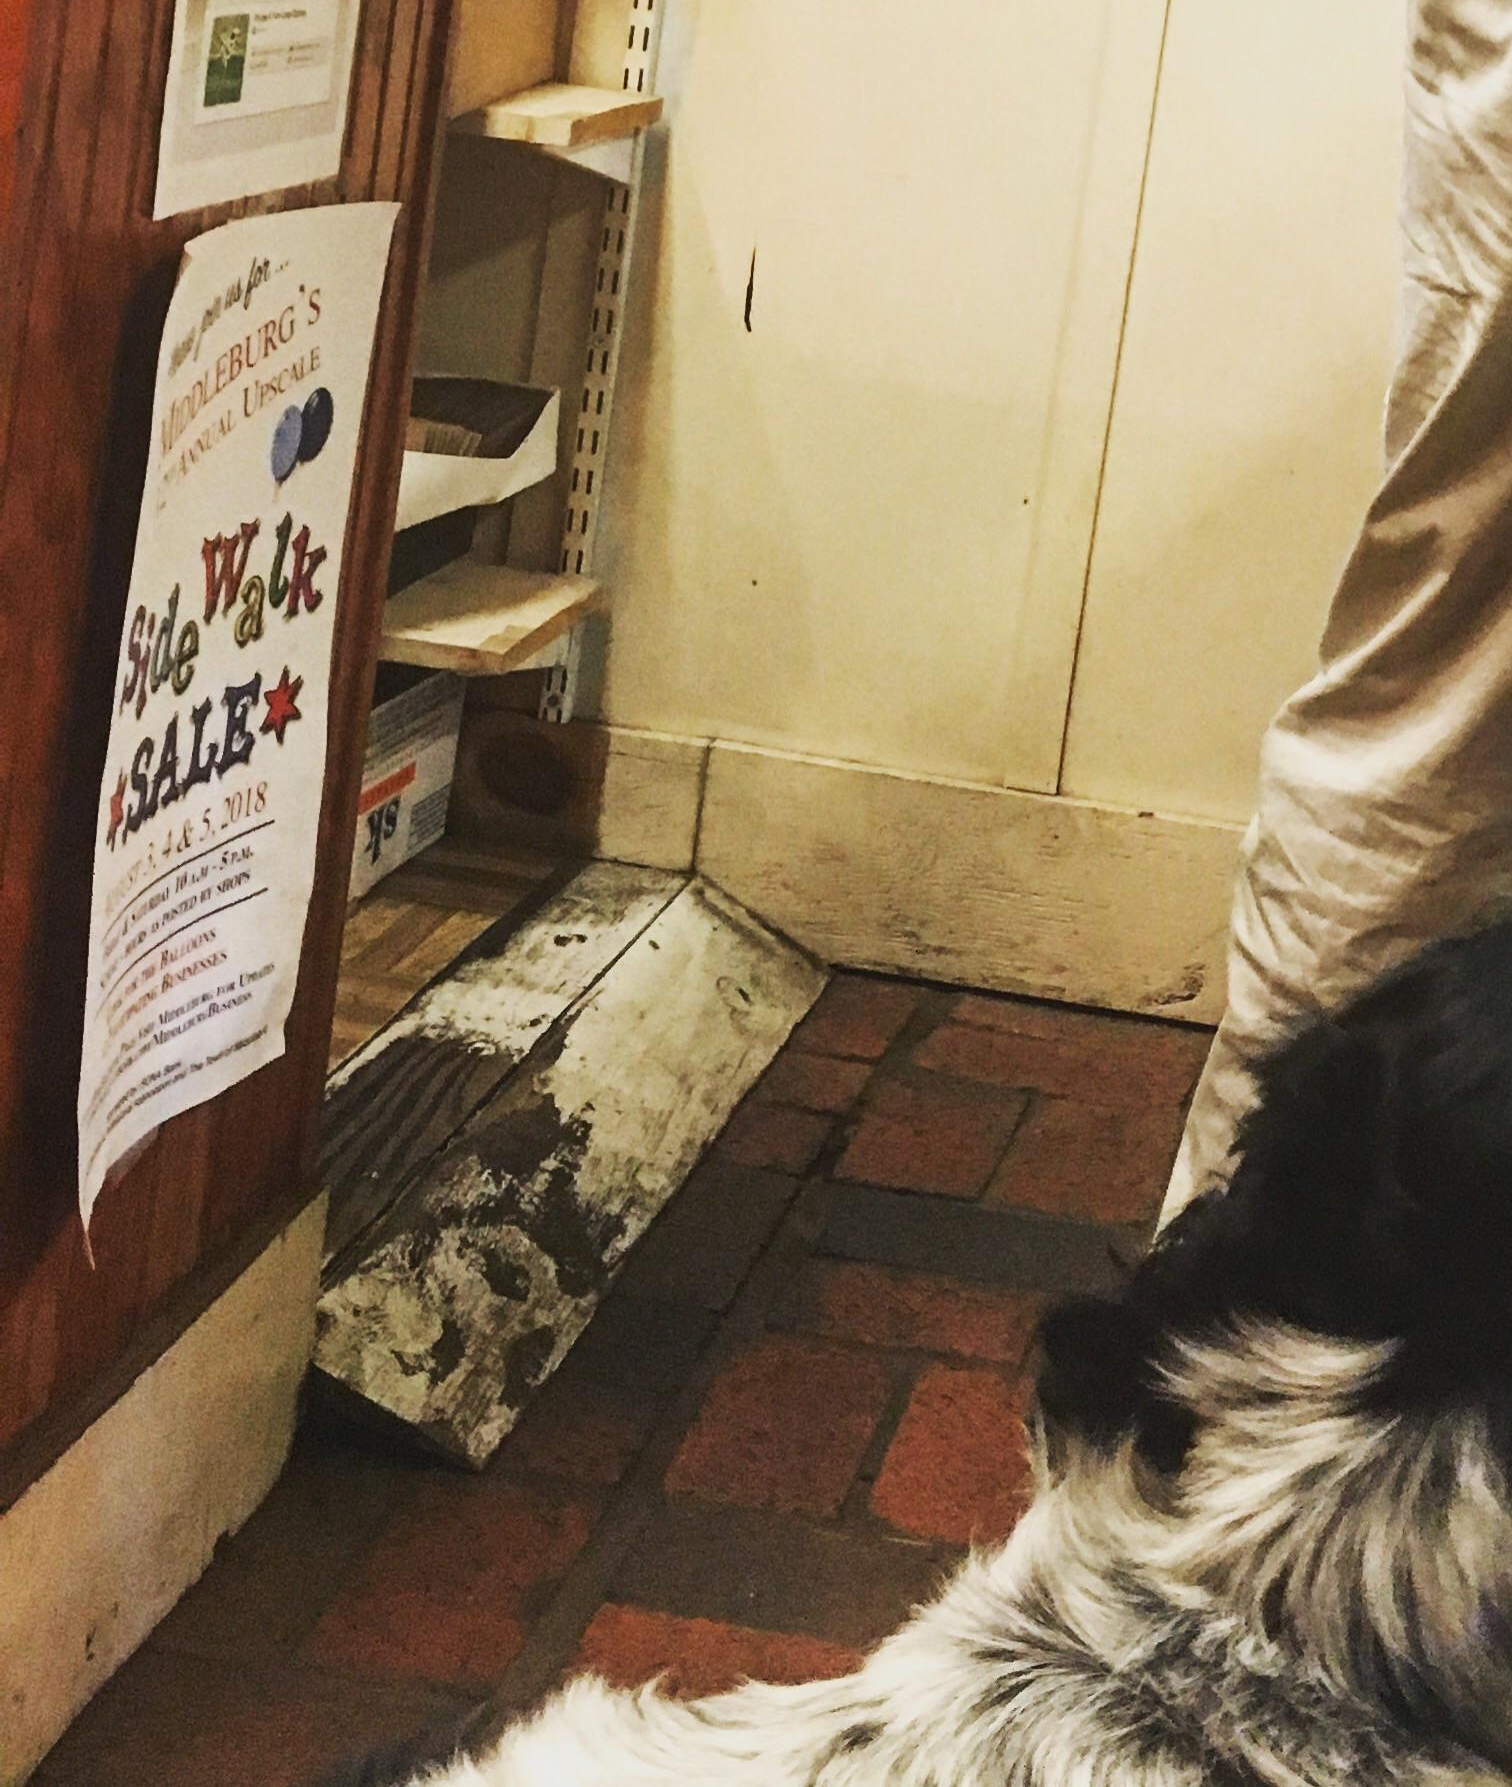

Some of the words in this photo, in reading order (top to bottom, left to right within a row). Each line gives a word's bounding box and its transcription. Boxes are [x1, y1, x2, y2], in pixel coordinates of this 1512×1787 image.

[120, 582, 198, 720] Side
[201, 511, 328, 649] Walk
[122, 671, 263, 846] SALE
[221, 781, 268, 830] 2018
